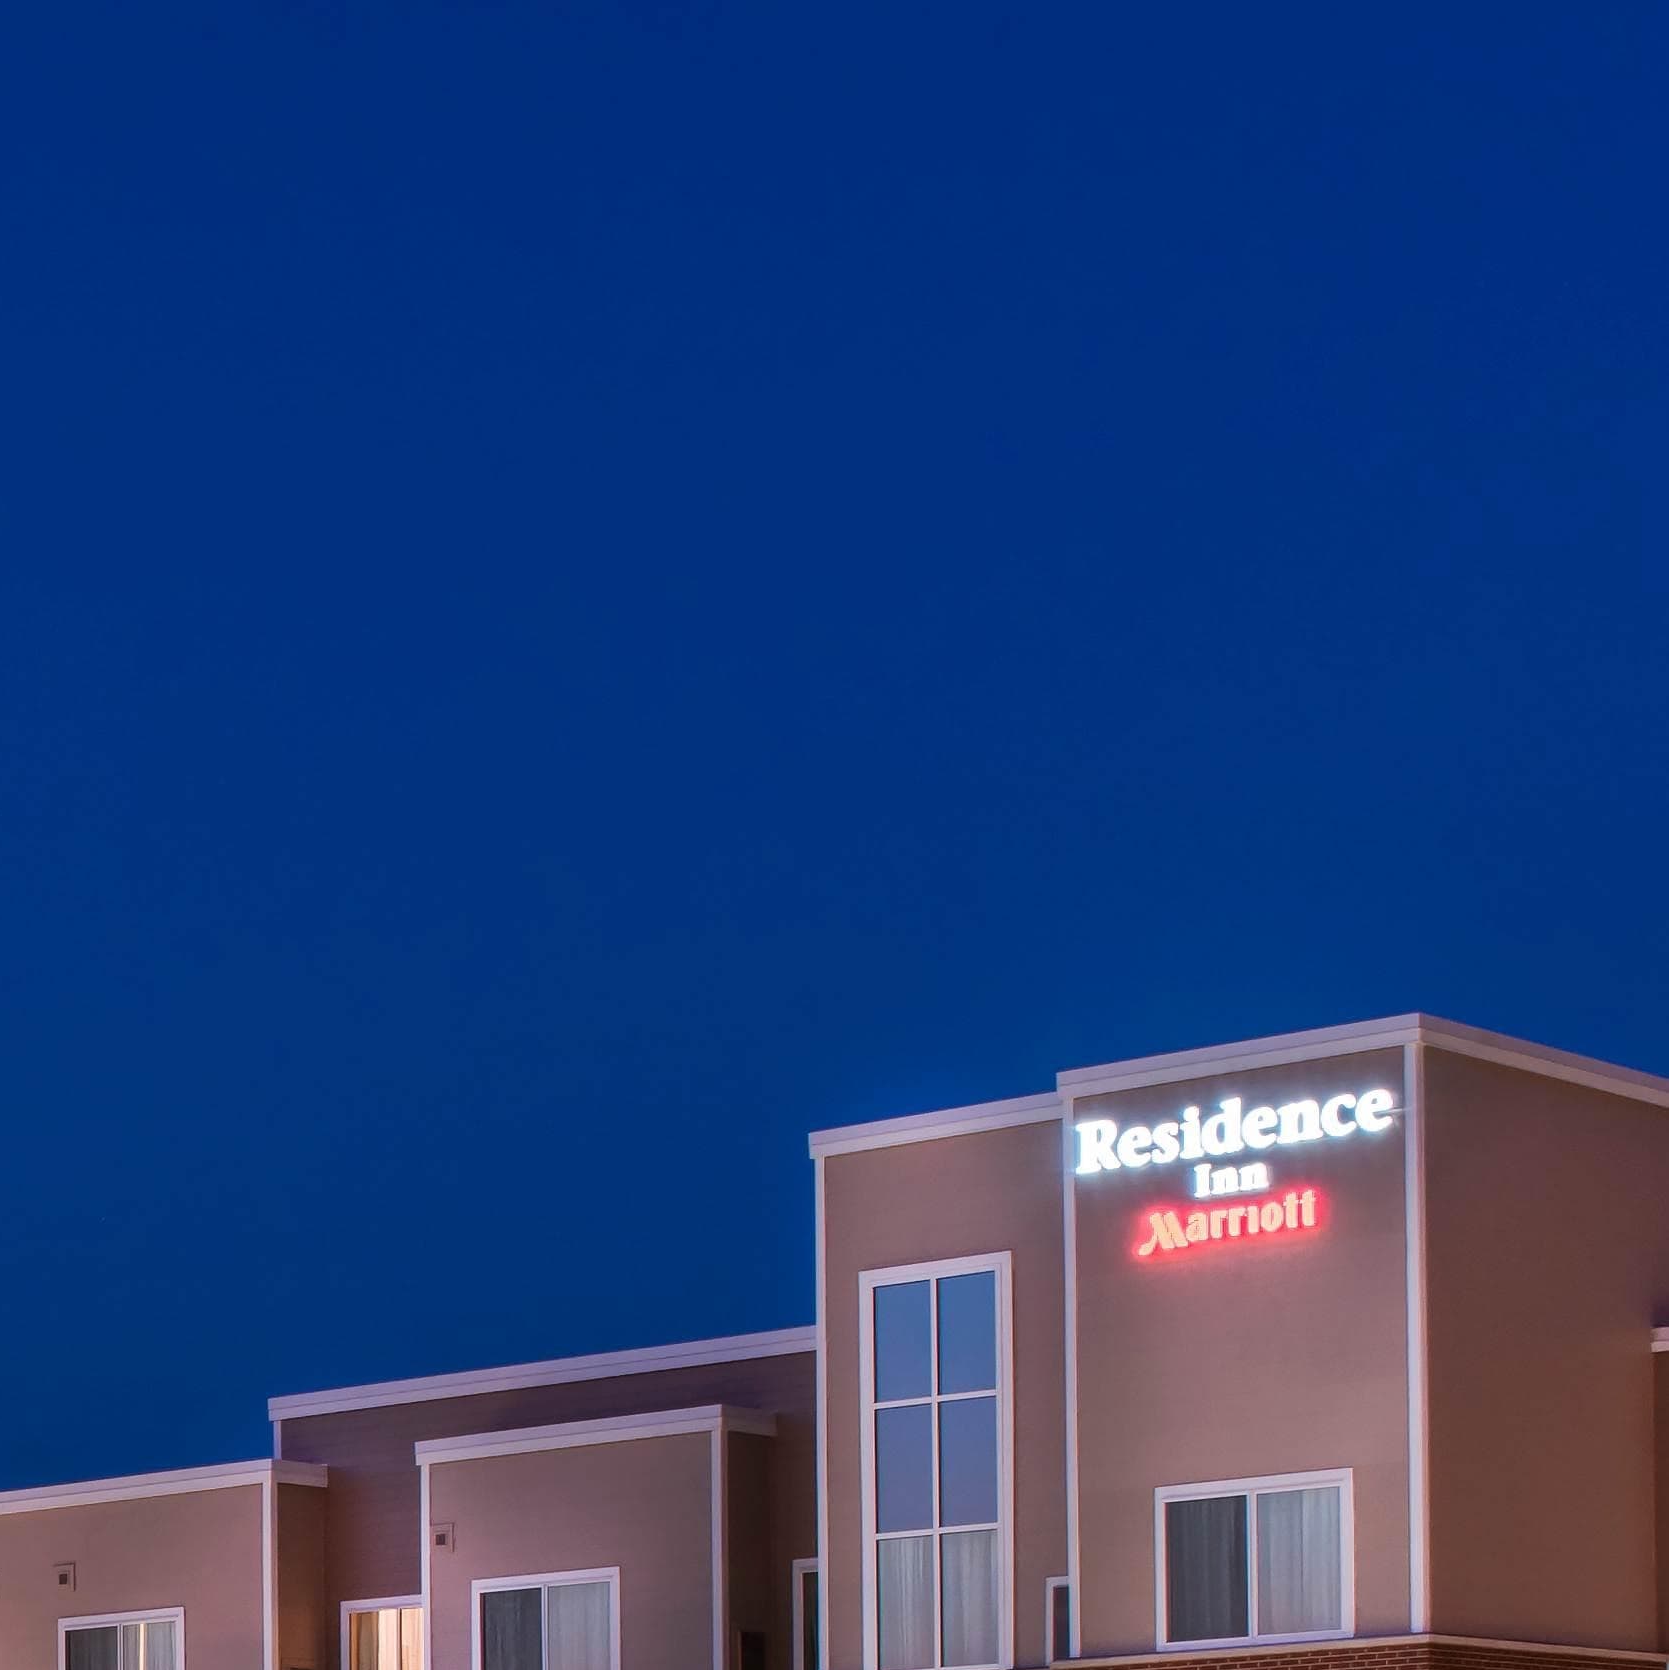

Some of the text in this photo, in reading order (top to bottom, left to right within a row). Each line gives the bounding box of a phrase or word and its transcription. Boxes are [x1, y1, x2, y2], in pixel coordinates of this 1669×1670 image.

[1075, 1088, 1394, 1175] Residence
[1193, 1162, 1269, 1199] Inn
[1137, 1189, 1317, 1256] Marriott
